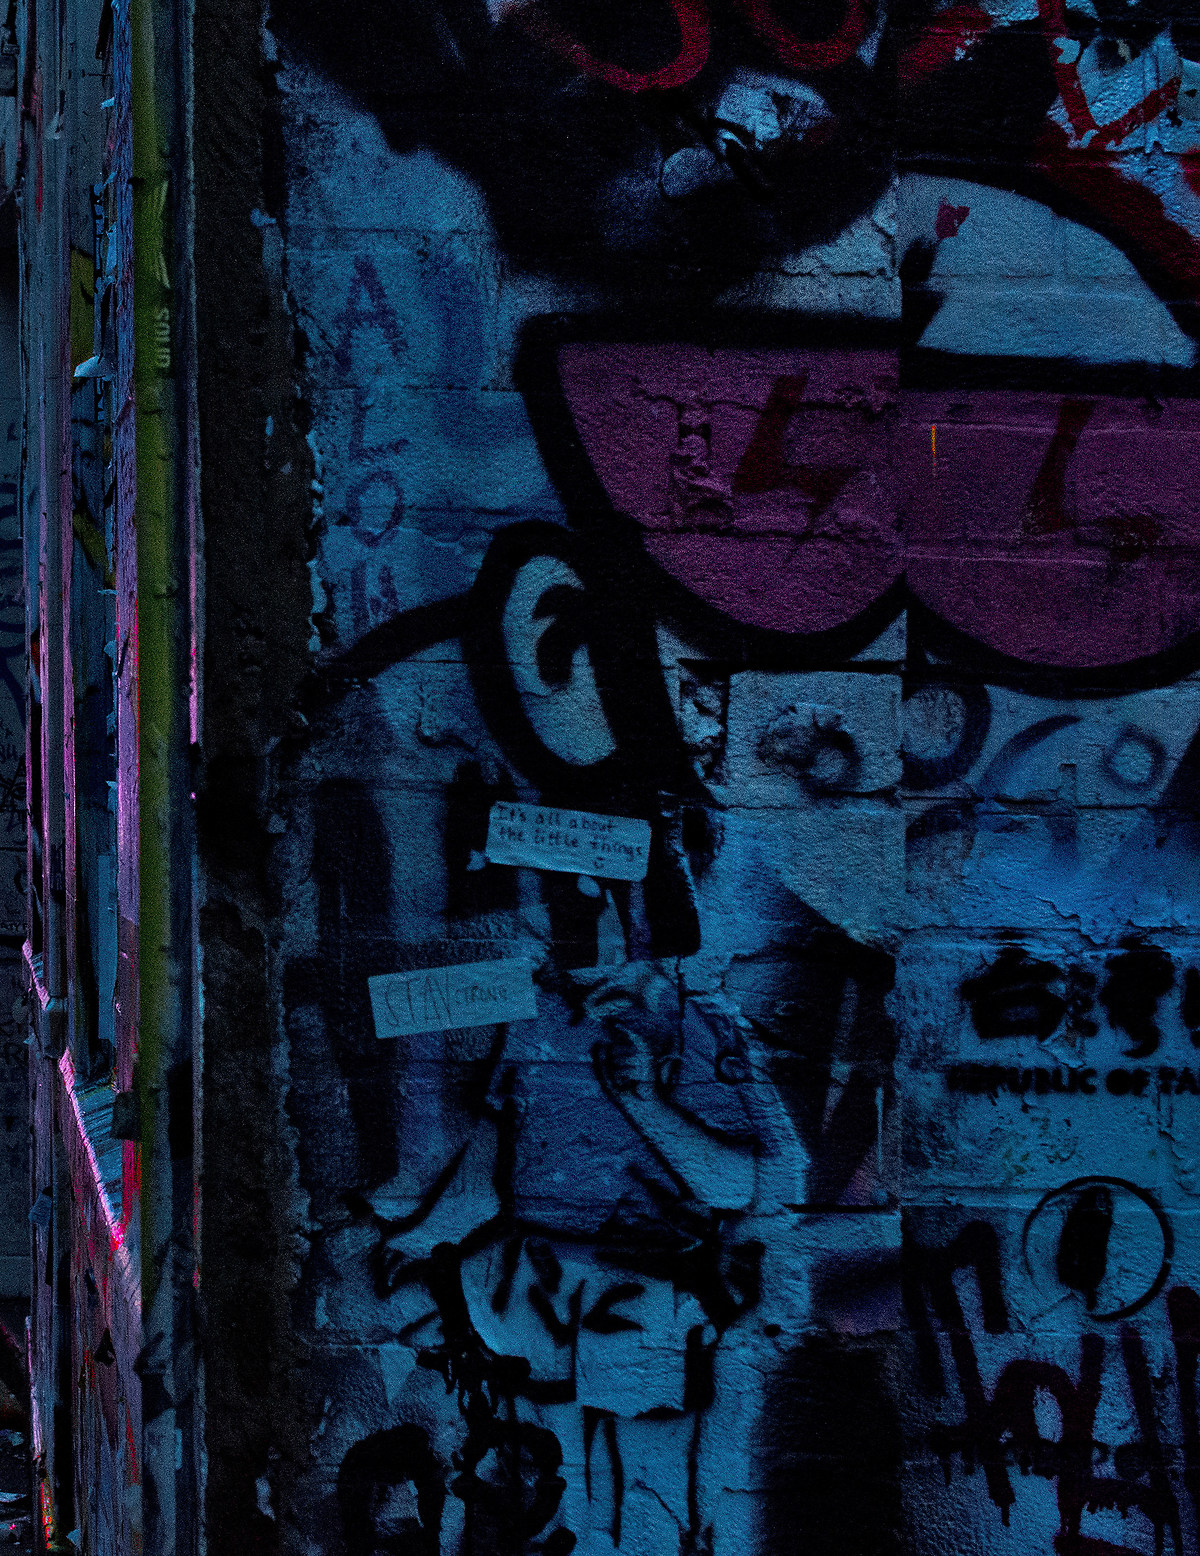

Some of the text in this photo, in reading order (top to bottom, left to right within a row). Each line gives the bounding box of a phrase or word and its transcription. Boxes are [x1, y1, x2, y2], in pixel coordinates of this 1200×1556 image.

[535, 811, 561, 826] all
[568, 814, 616, 833] about
[499, 825, 525, 843] the
[534, 827, 579, 848] little
[1106, 1068, 1150, 1096] OF
